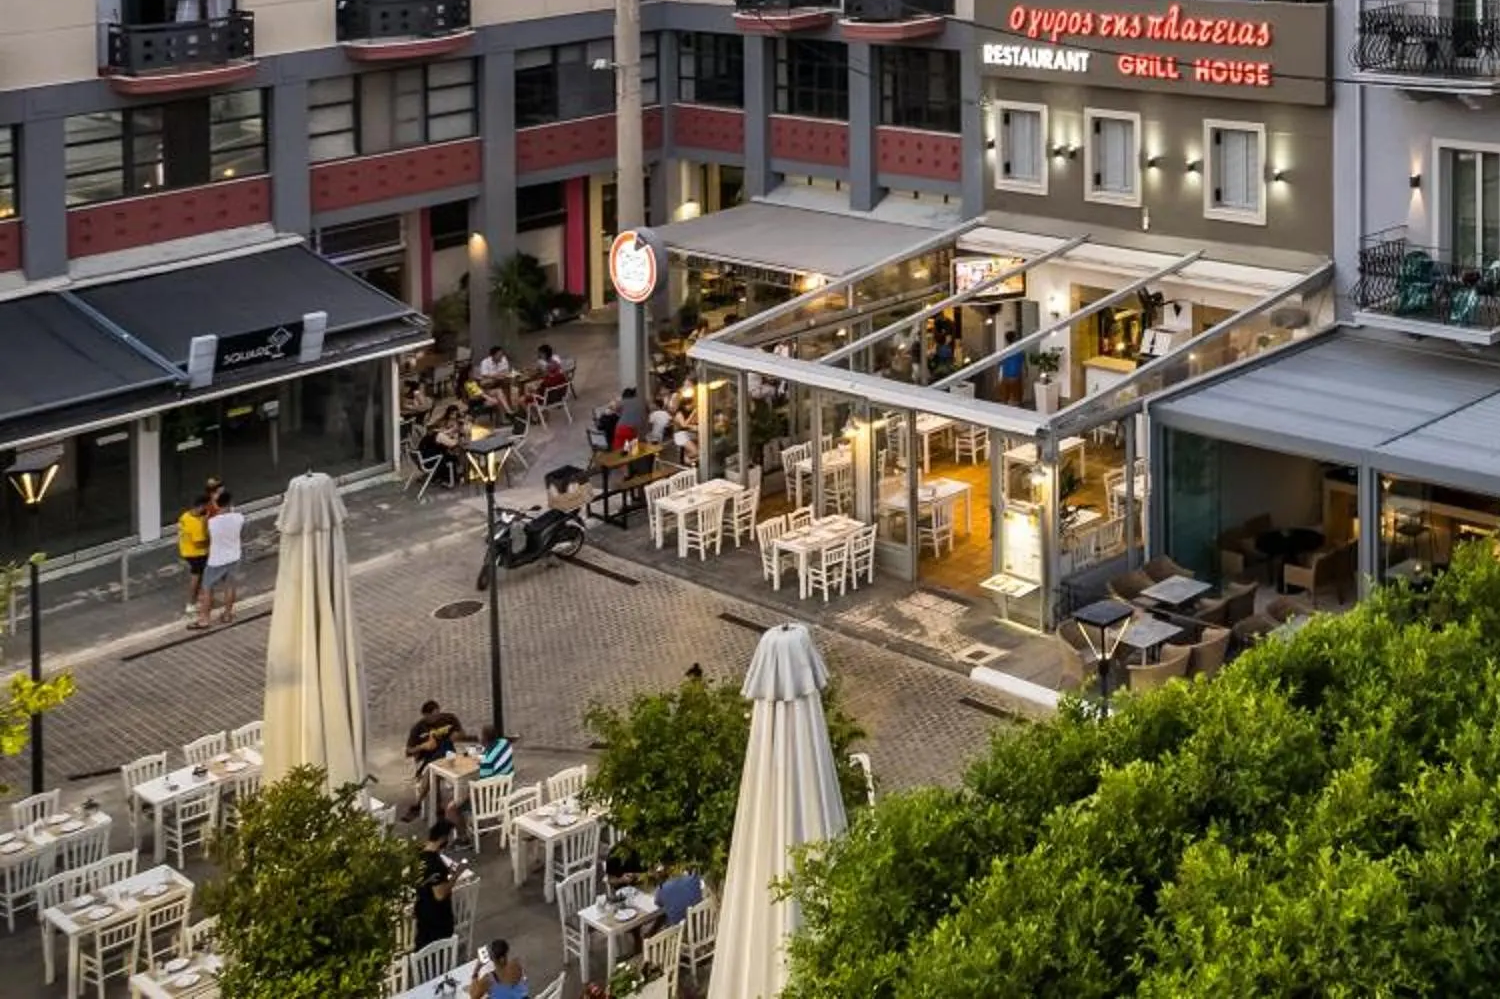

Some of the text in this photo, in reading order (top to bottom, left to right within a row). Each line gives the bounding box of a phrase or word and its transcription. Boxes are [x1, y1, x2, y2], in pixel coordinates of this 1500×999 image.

[1028, 10, 1092, 42] γυρος
[1100, 13, 1141, 38] της
[1147, 4, 1270, 46] πλατειας
[983, 43, 1270, 86] RESTAURANT GRILL HOUSE
